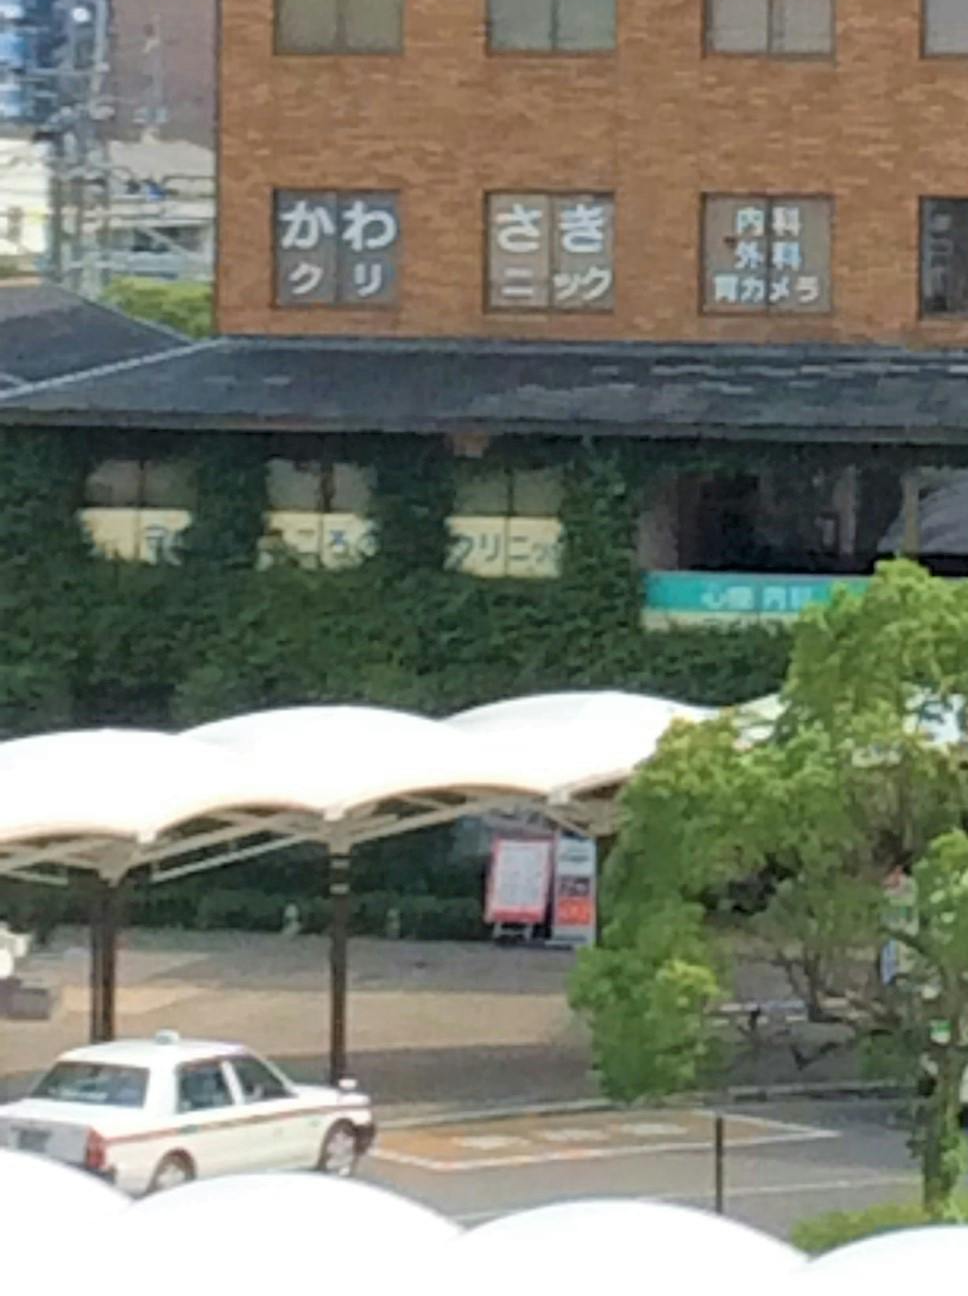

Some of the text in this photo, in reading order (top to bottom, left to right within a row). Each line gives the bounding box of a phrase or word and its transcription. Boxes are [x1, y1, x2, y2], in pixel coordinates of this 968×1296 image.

[280, 200, 396, 251] かわ
[736, 206, 801, 237] 内科
[734, 240, 802, 271] 外科
[289, 262, 613, 301] クリ ニック
[713, 274, 820, 304] 胃カメラ
